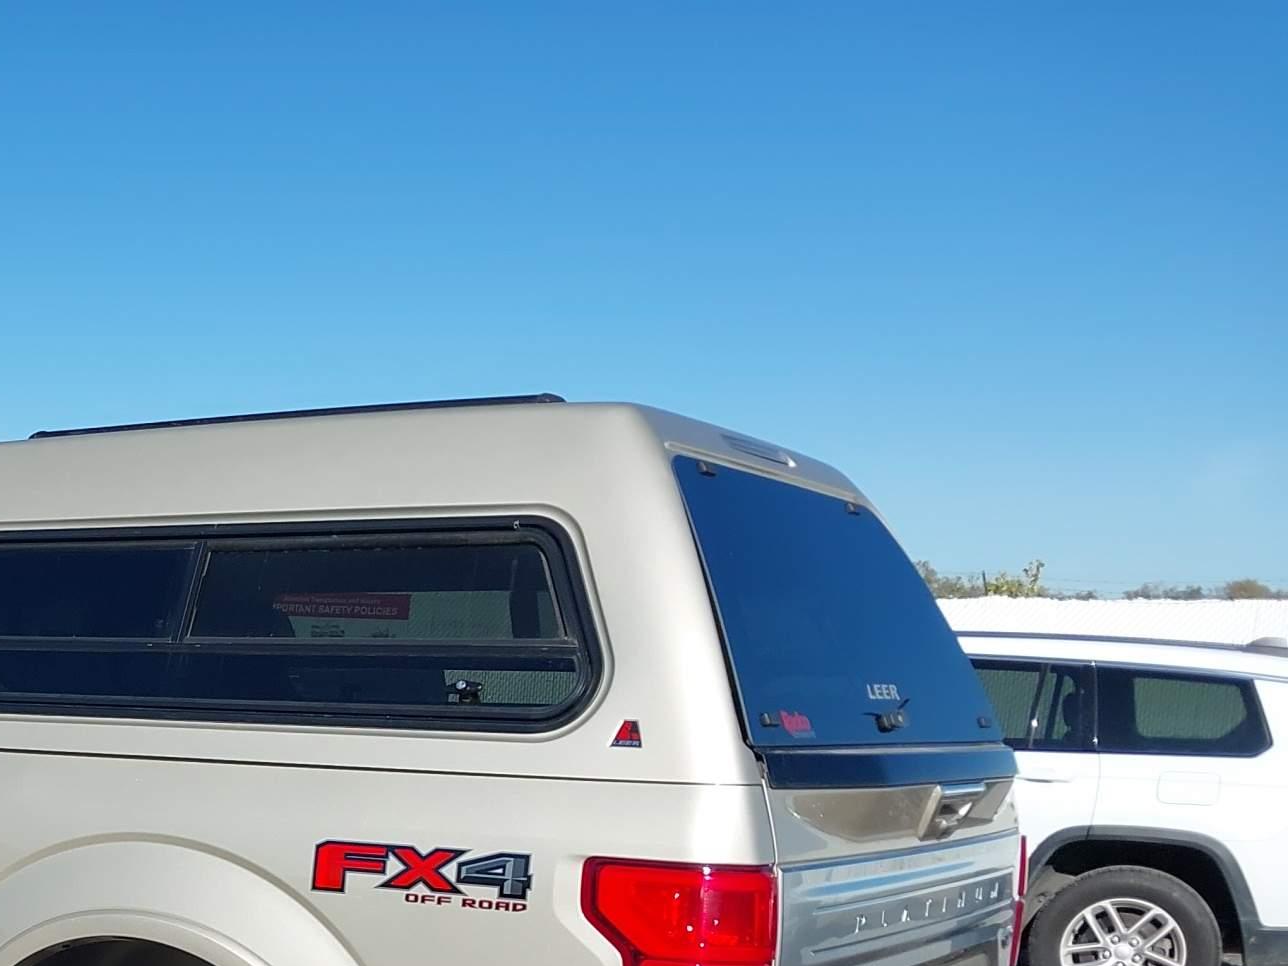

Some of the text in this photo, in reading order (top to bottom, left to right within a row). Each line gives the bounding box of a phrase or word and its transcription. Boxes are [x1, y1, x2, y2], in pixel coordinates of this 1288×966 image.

[319, 604, 352, 615] SAFETY
[354, 605, 399, 616] POLICIES
[867, 684, 901, 700] LEER
[312, 839, 532, 900] FX4
[405, 893, 527, 913] OFF ROAD
[854, 881, 999, 935] PLATINUM
